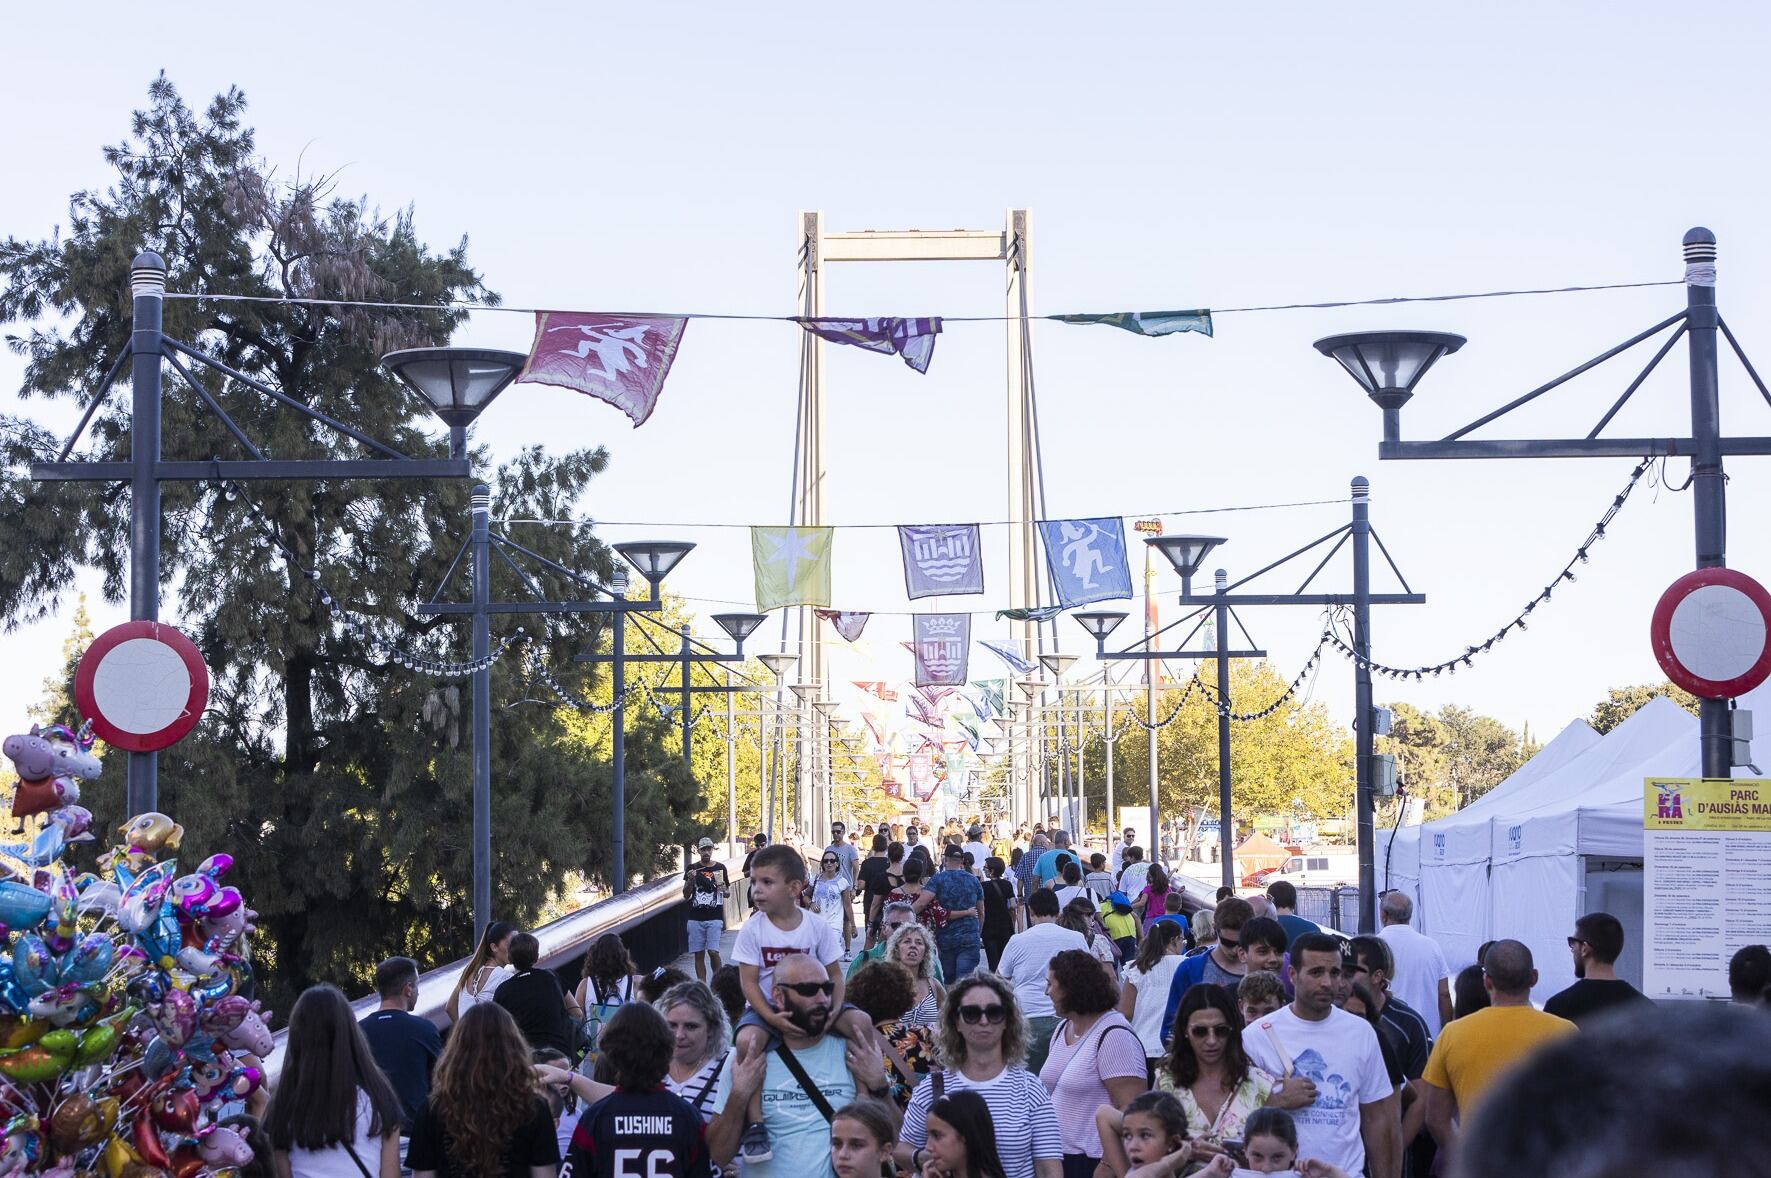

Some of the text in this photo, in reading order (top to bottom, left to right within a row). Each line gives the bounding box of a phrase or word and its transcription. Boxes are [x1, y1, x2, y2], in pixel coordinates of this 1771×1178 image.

[1730, 790, 1759, 801] PARC
[1339, 940, 1352, 956] NY
[615, 1116, 672, 1135] CUSHING
[614, 1149, 675, 1178] 56
